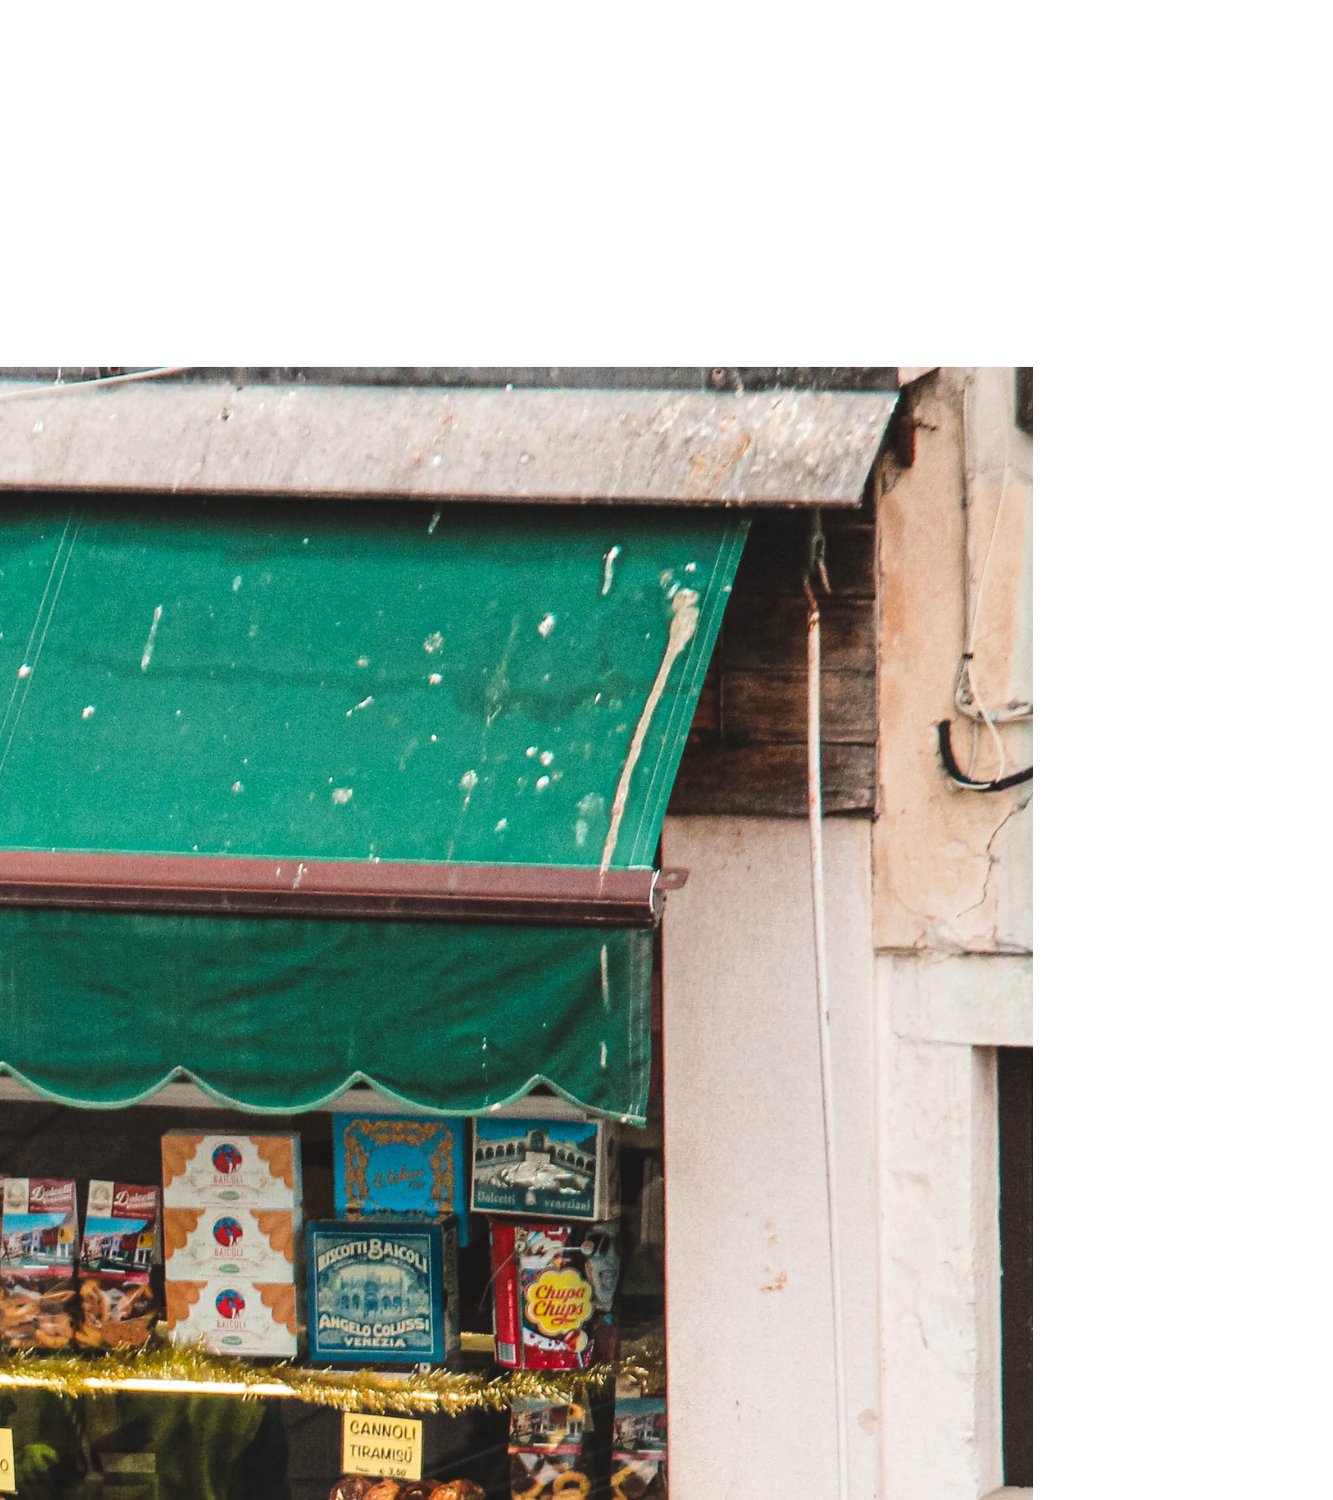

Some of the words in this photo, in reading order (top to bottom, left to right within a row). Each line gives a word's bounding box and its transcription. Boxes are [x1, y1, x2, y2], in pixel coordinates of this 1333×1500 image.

[318, 1240, 368, 1273] BISCOTTI
[368, 1238, 428, 1273] BAICOLI
[535, 1284, 586, 1302] Chupa
[533, 1301, 584, 1317] Chups
[318, 1313, 372, 1337] ANGELO
[373, 1318, 430, 1338] COLUSSI
[344, 1336, 407, 1348] VENEZIA
[349, 1419, 417, 1440] CANNOLI
